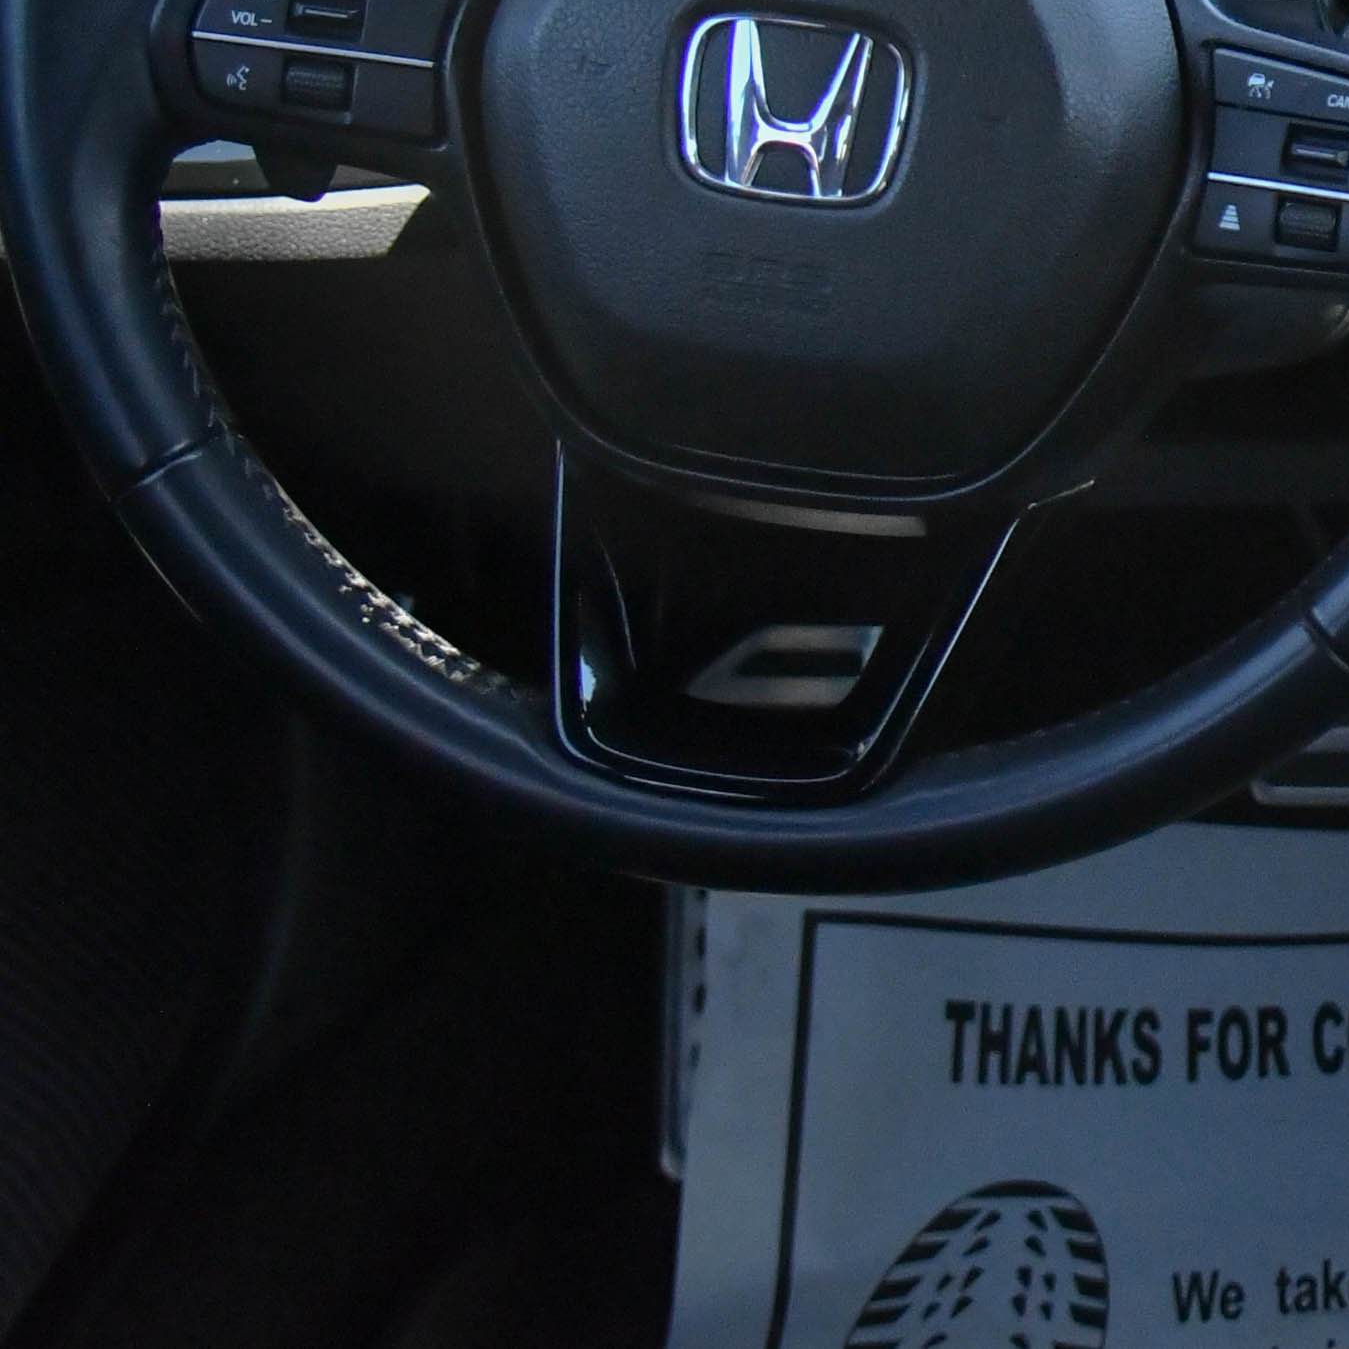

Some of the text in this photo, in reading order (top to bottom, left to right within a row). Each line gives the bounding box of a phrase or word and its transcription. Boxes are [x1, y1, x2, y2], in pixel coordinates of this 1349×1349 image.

[944, 997, 1163, 1090] THANKS
[1184, 1003, 1293, 1084] FOR
[1171, 1266, 1246, 1324] We
